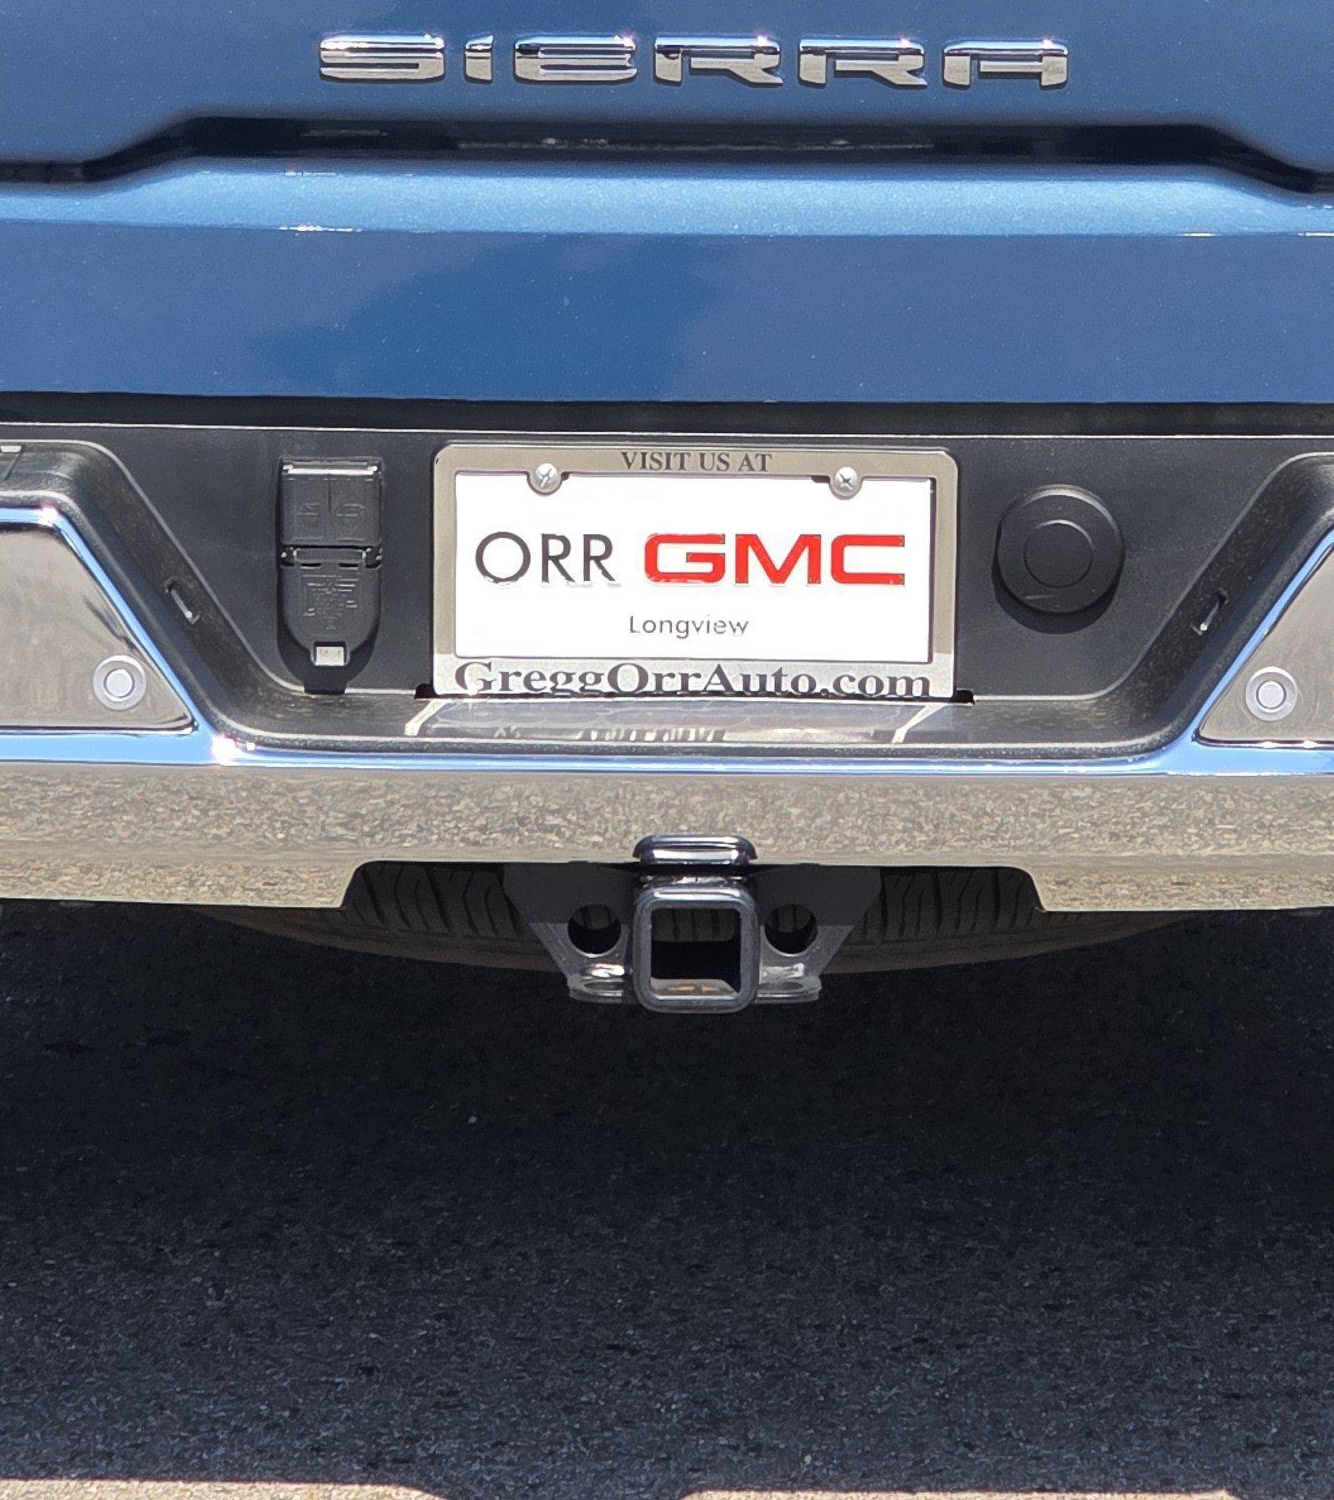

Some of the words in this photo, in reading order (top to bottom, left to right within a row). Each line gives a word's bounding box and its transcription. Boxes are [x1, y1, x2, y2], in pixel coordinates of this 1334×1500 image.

[318, 33, 1069, 87] SIERRA
[621, 452, 694, 472] VISIT
[698, 453, 731, 472] US
[738, 453, 773, 473] AT
[474, 531, 617, 586] ORR
[643, 532, 906, 586] GMC
[629, 615, 750, 638] Longview
[454, 660, 932, 698] GreggOrrAuto.com
